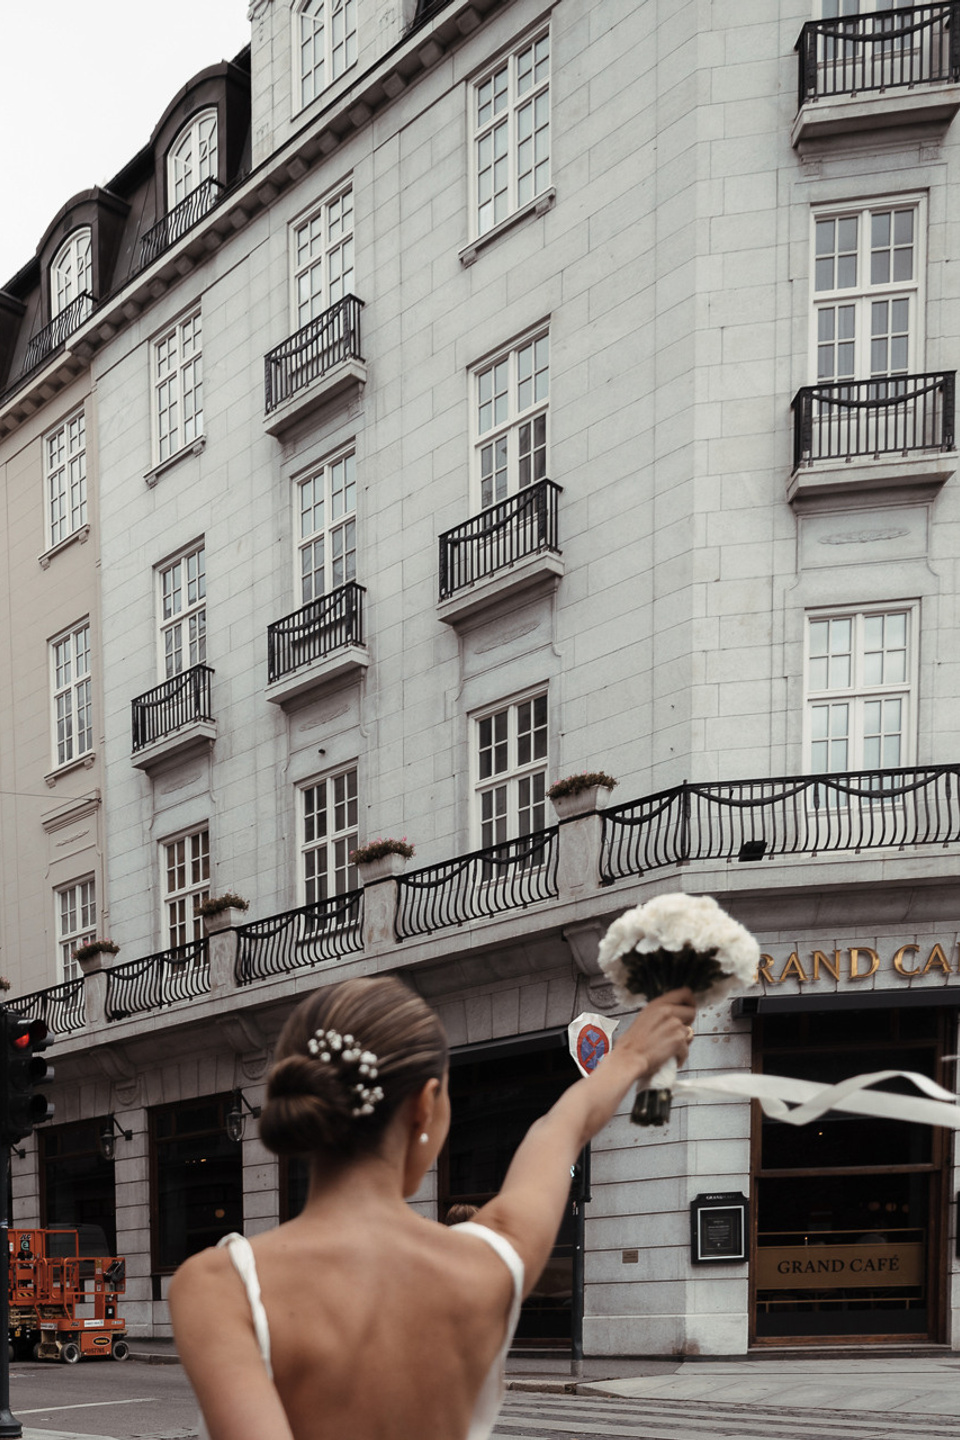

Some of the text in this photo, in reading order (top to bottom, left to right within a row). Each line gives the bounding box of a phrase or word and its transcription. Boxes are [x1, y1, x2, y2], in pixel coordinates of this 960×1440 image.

[754, 942, 960, 984] RAND CA
[777, 1255, 900, 1274] GRAND CAFÉ
